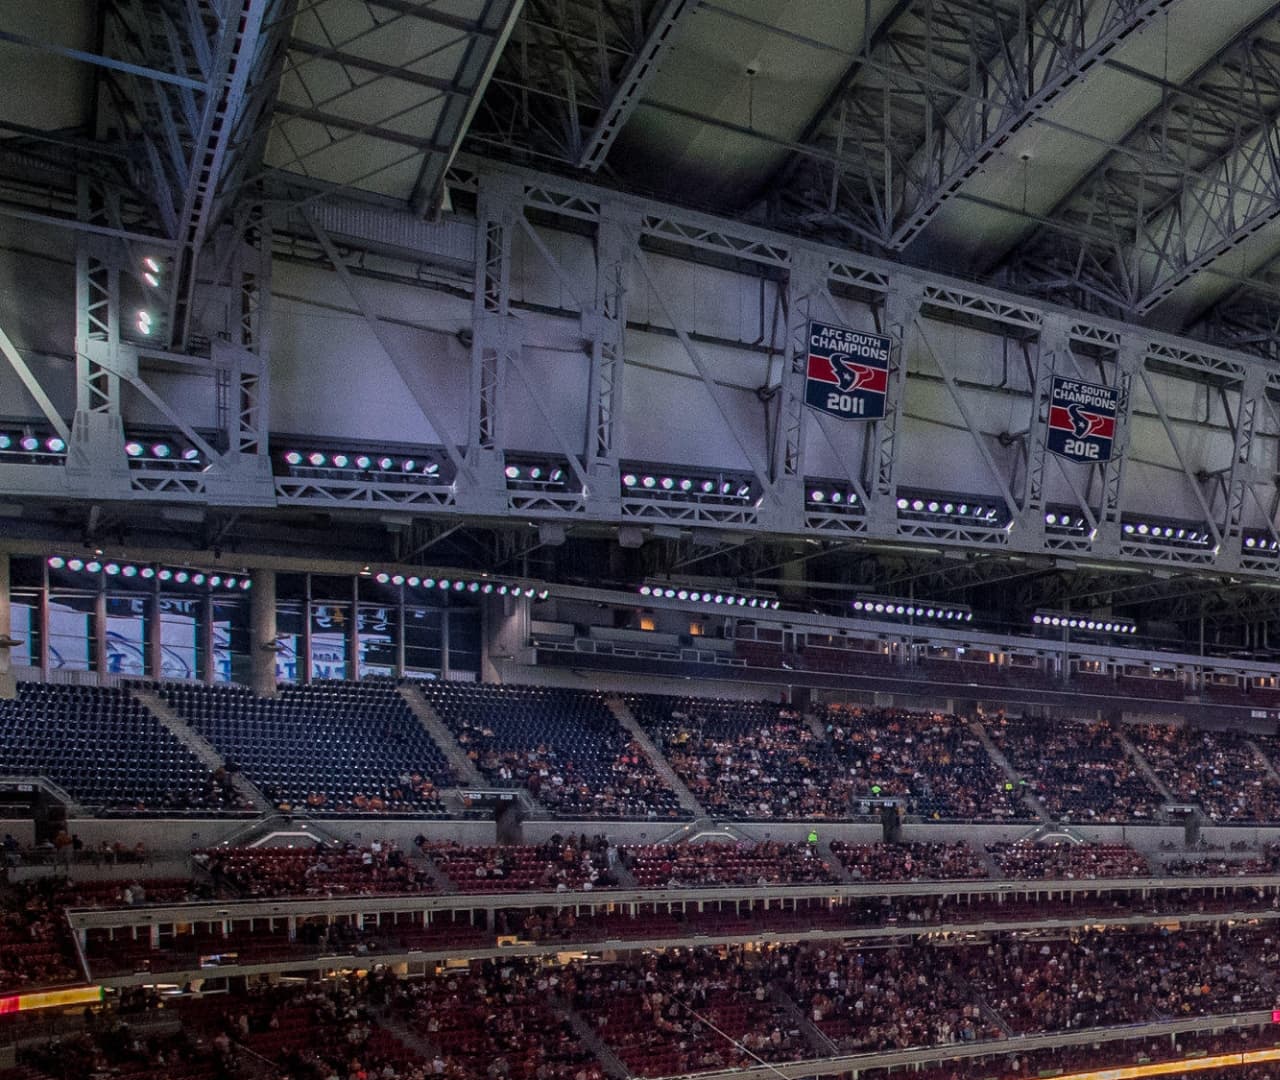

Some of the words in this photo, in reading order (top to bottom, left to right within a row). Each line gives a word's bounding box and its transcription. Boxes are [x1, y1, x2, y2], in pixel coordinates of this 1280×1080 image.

[811, 335, 888, 361] CHAMPIONS
[821, 327, 842, 339] AFC
[845, 332, 881, 348] SOUTH
[1053, 388, 1116, 410] CHAMPIONS
[1062, 381, 1079, 393] AFC
[1080, 385, 1112, 398] SOUTH
[827, 393, 865, 415] 2011
[1064, 439, 1100, 459] 2012
